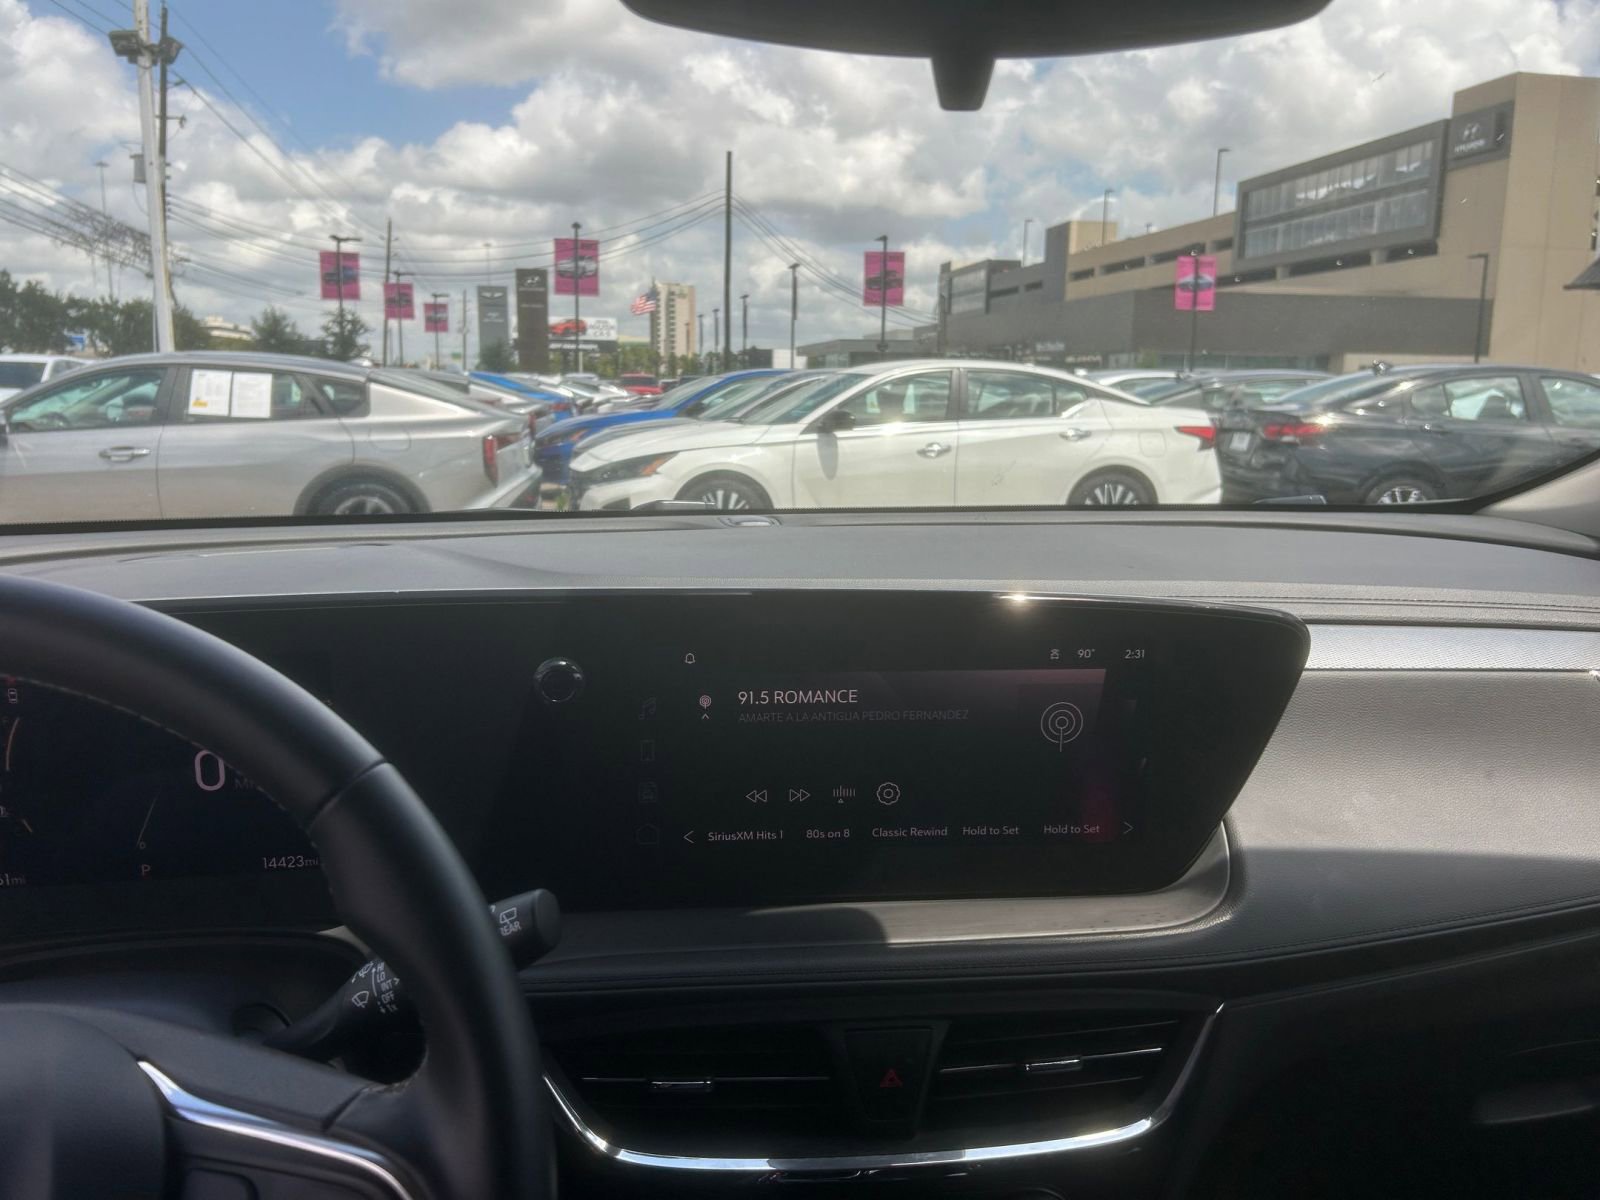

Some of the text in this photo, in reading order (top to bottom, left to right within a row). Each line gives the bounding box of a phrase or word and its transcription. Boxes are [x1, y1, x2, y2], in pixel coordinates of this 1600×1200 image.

[1077, 648, 1096, 659] 90°
[1124, 648, 1145, 660] 2:31
[737, 689, 859, 705] 91.5 ROMANCE
[738, 709, 969, 722] AMARTE A LA ANTIGUA PEDRO FERNANDEZ
[194, 749, 227, 791] 0
[707, 830, 754, 842] SiriusXM
[756, 829, 777, 841] Hits
[805, 828, 850, 839] 80s on 8
[871, 826, 949, 838] Classic Rewind
[962, 825, 1020, 836] Hold to Set
[1043, 824, 1101, 835] Hold to Set
[141, 864, 151, 876] P
[376, 971, 386, 983] LO
[380, 990, 395, 1004] OFF
